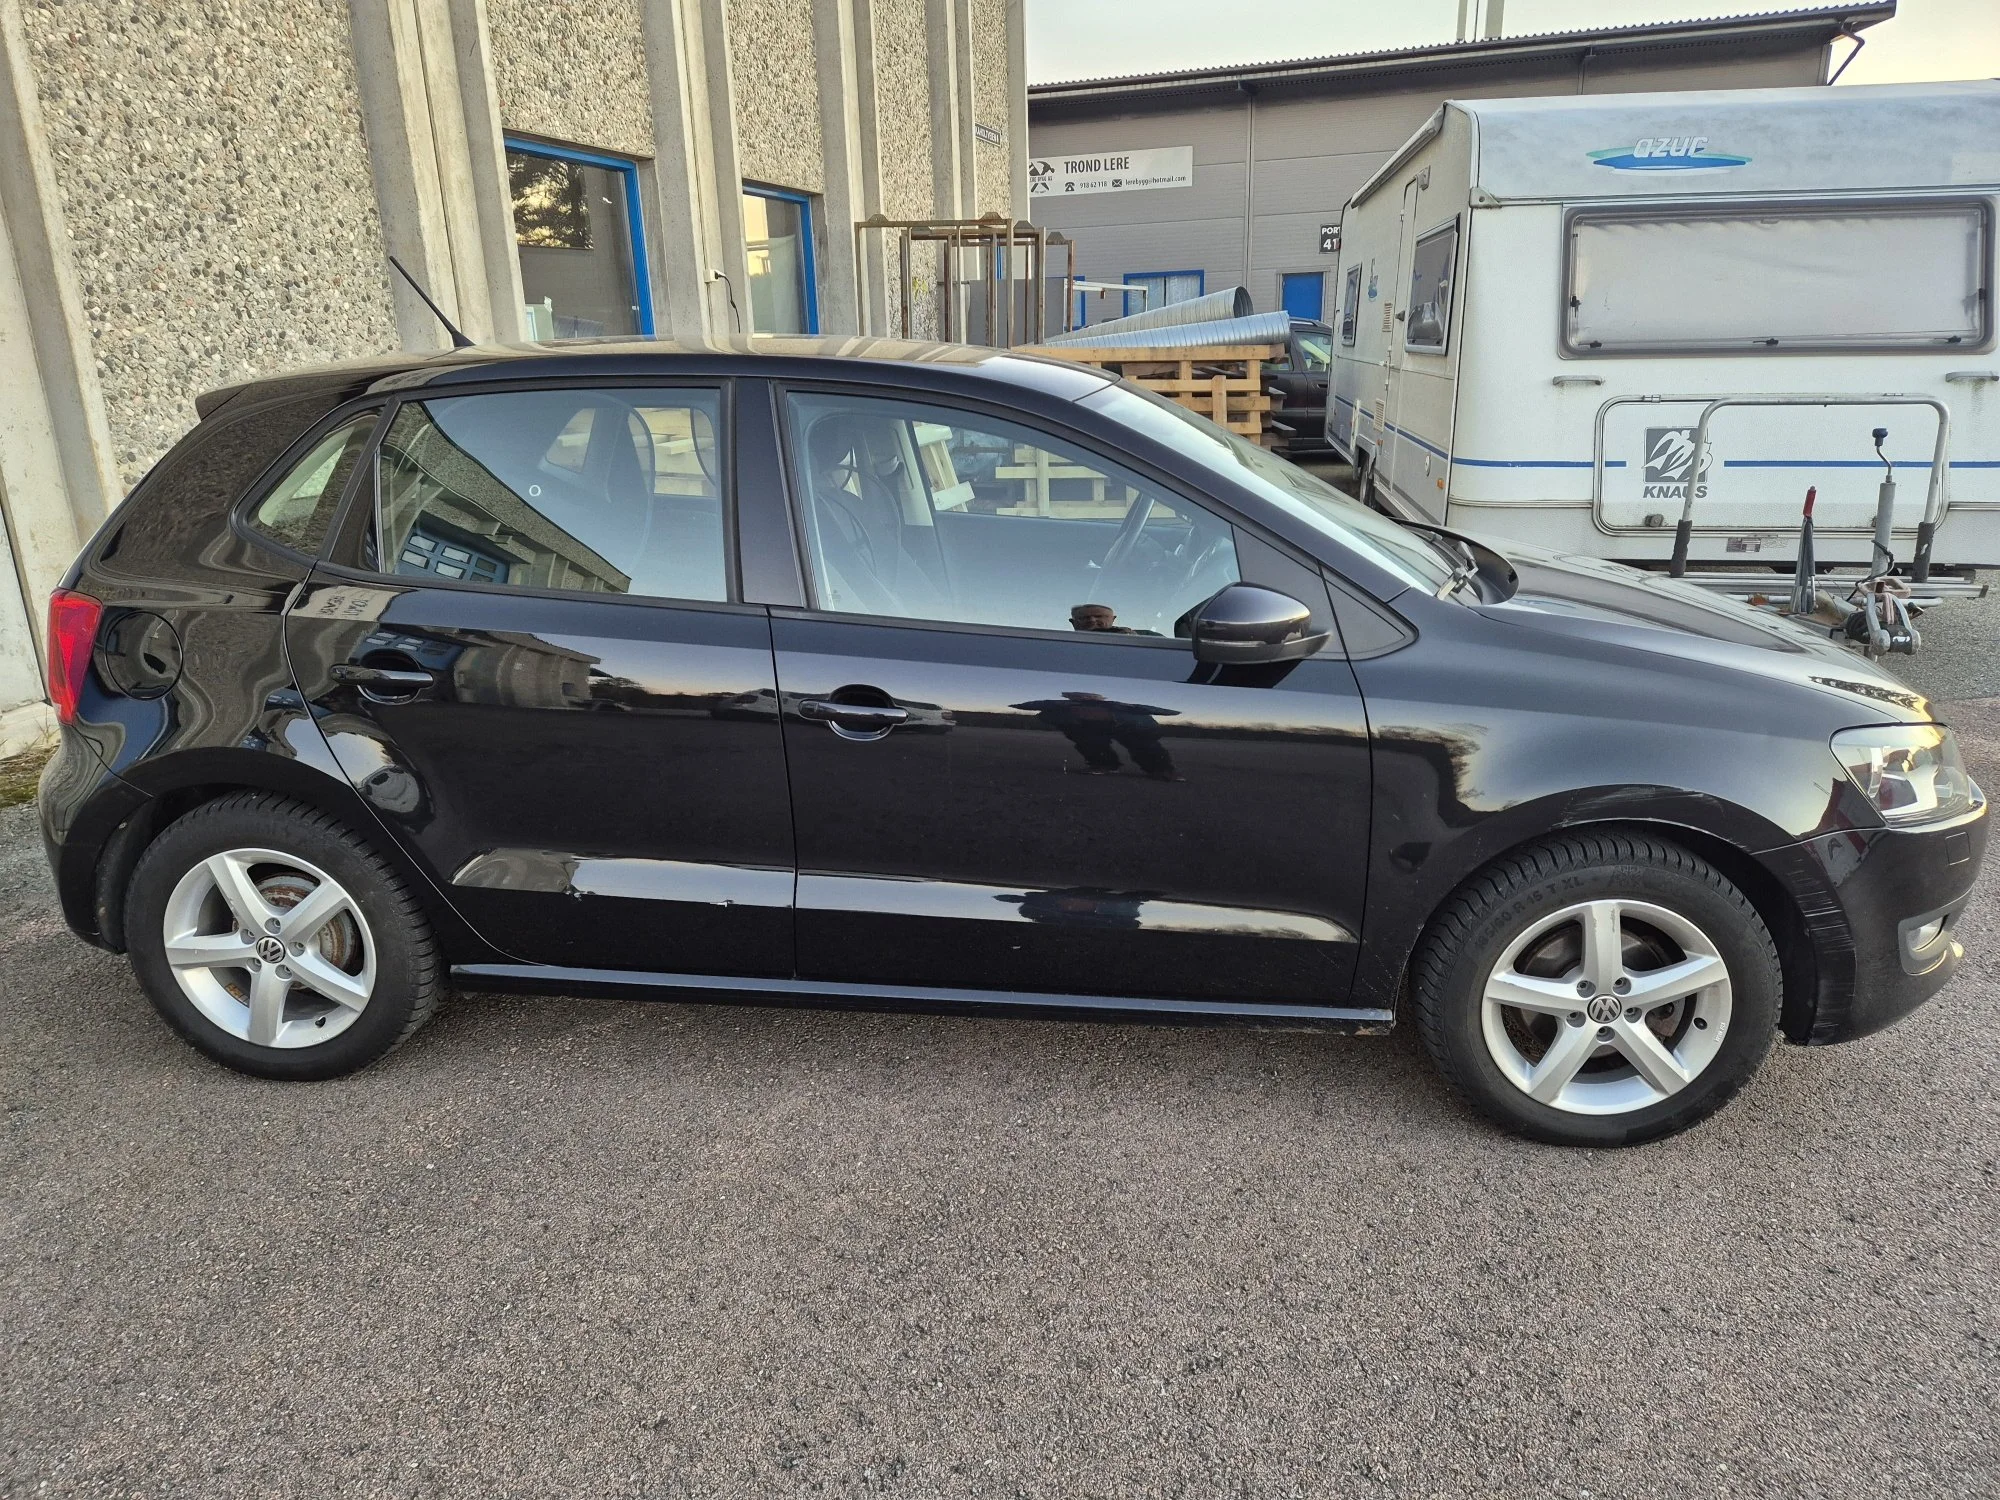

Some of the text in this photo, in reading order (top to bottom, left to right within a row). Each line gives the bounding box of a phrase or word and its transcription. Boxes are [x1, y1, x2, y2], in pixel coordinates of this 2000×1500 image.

[1063, 156, 1130, 174] TROND LERE
[1588, 994, 1621, 1024] VW
